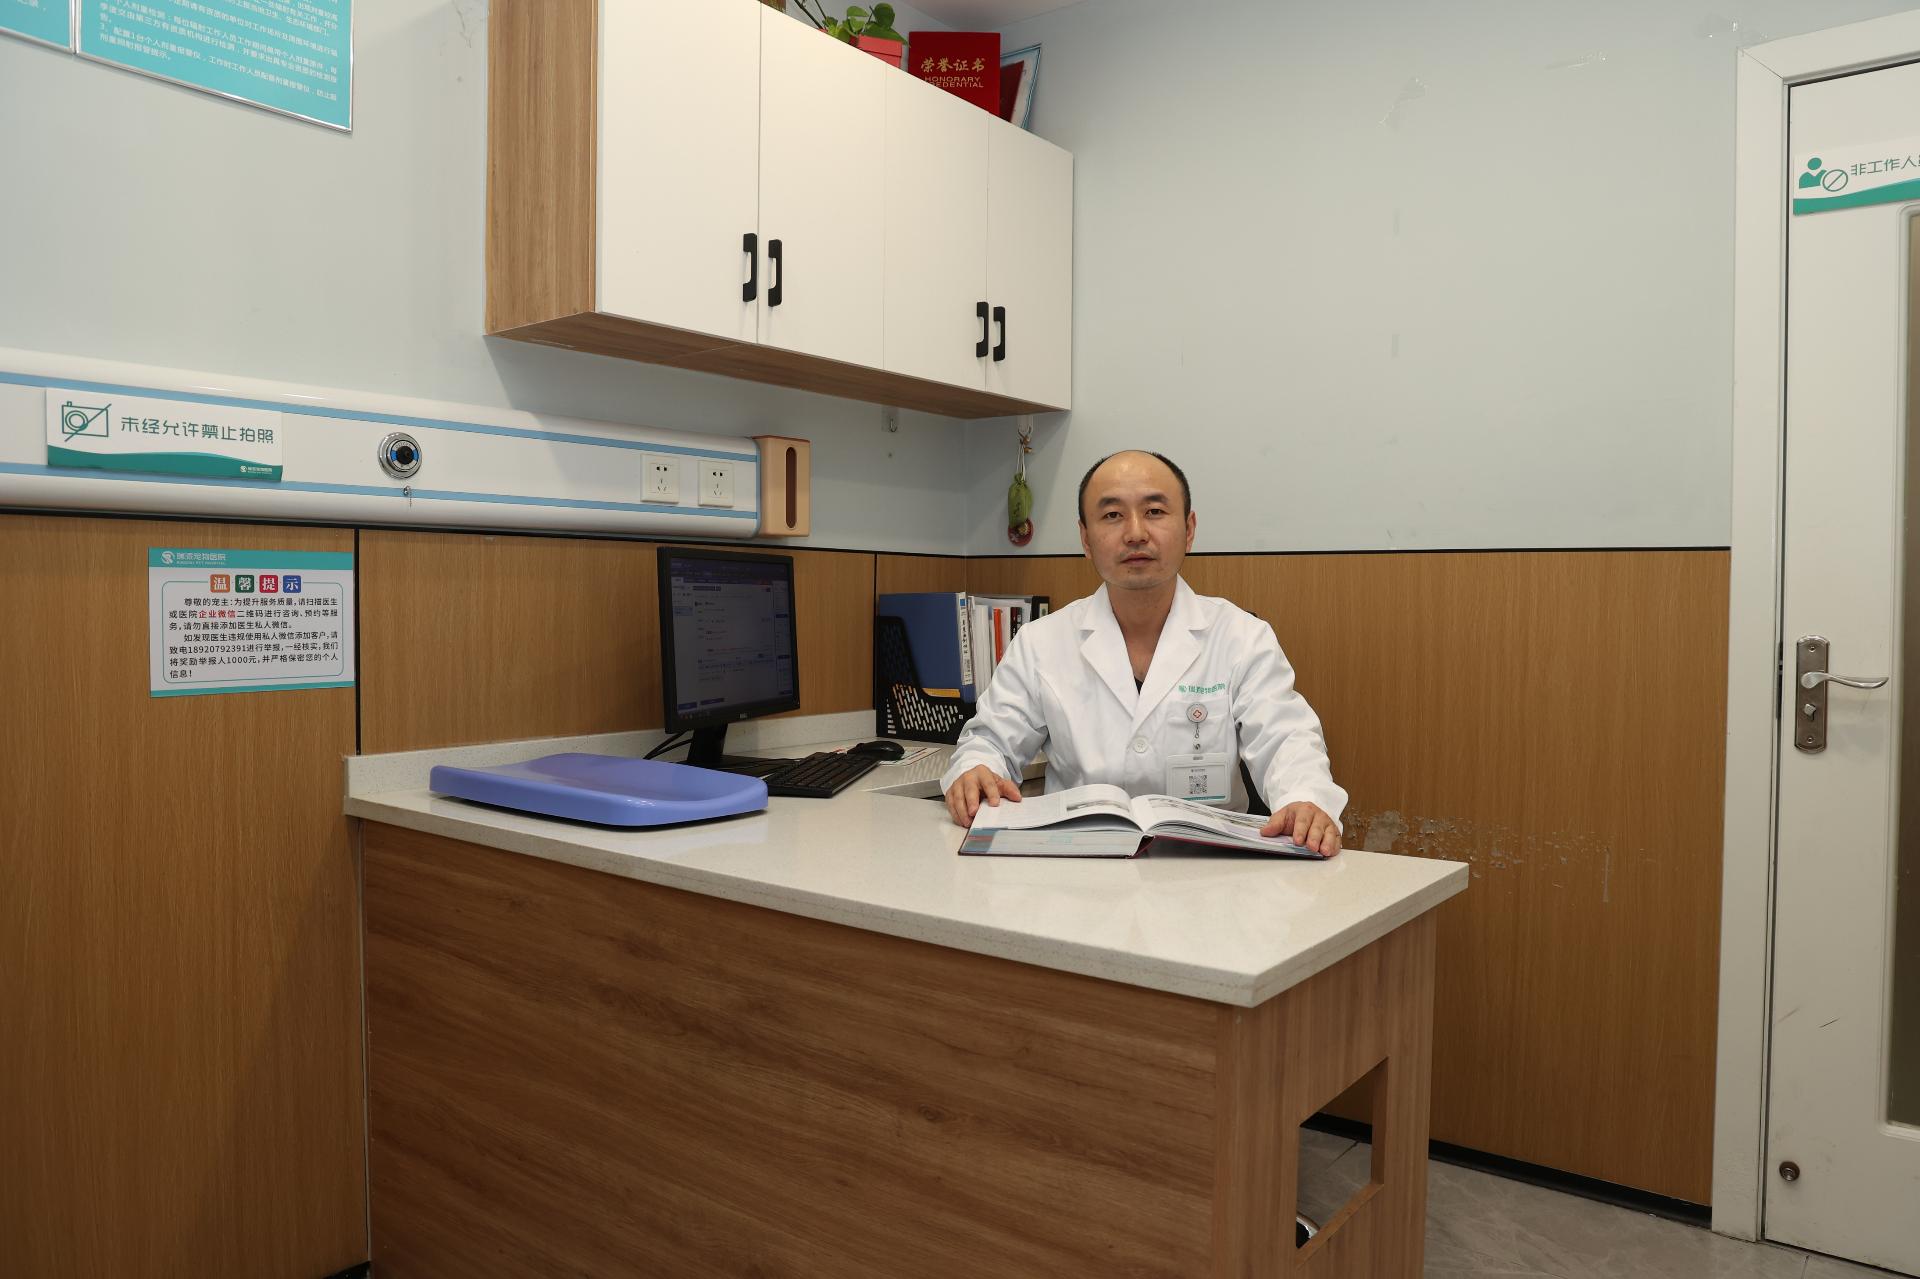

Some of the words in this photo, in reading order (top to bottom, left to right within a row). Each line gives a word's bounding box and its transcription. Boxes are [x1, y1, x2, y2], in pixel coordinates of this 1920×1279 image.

[921, 57, 985, 72] 荣誉证书
[1850, 155, 1920, 176] 非工作人
[120, 416, 274, 444] 未经允许禁止拍照
[213, 576, 299, 591] 温馨提示
